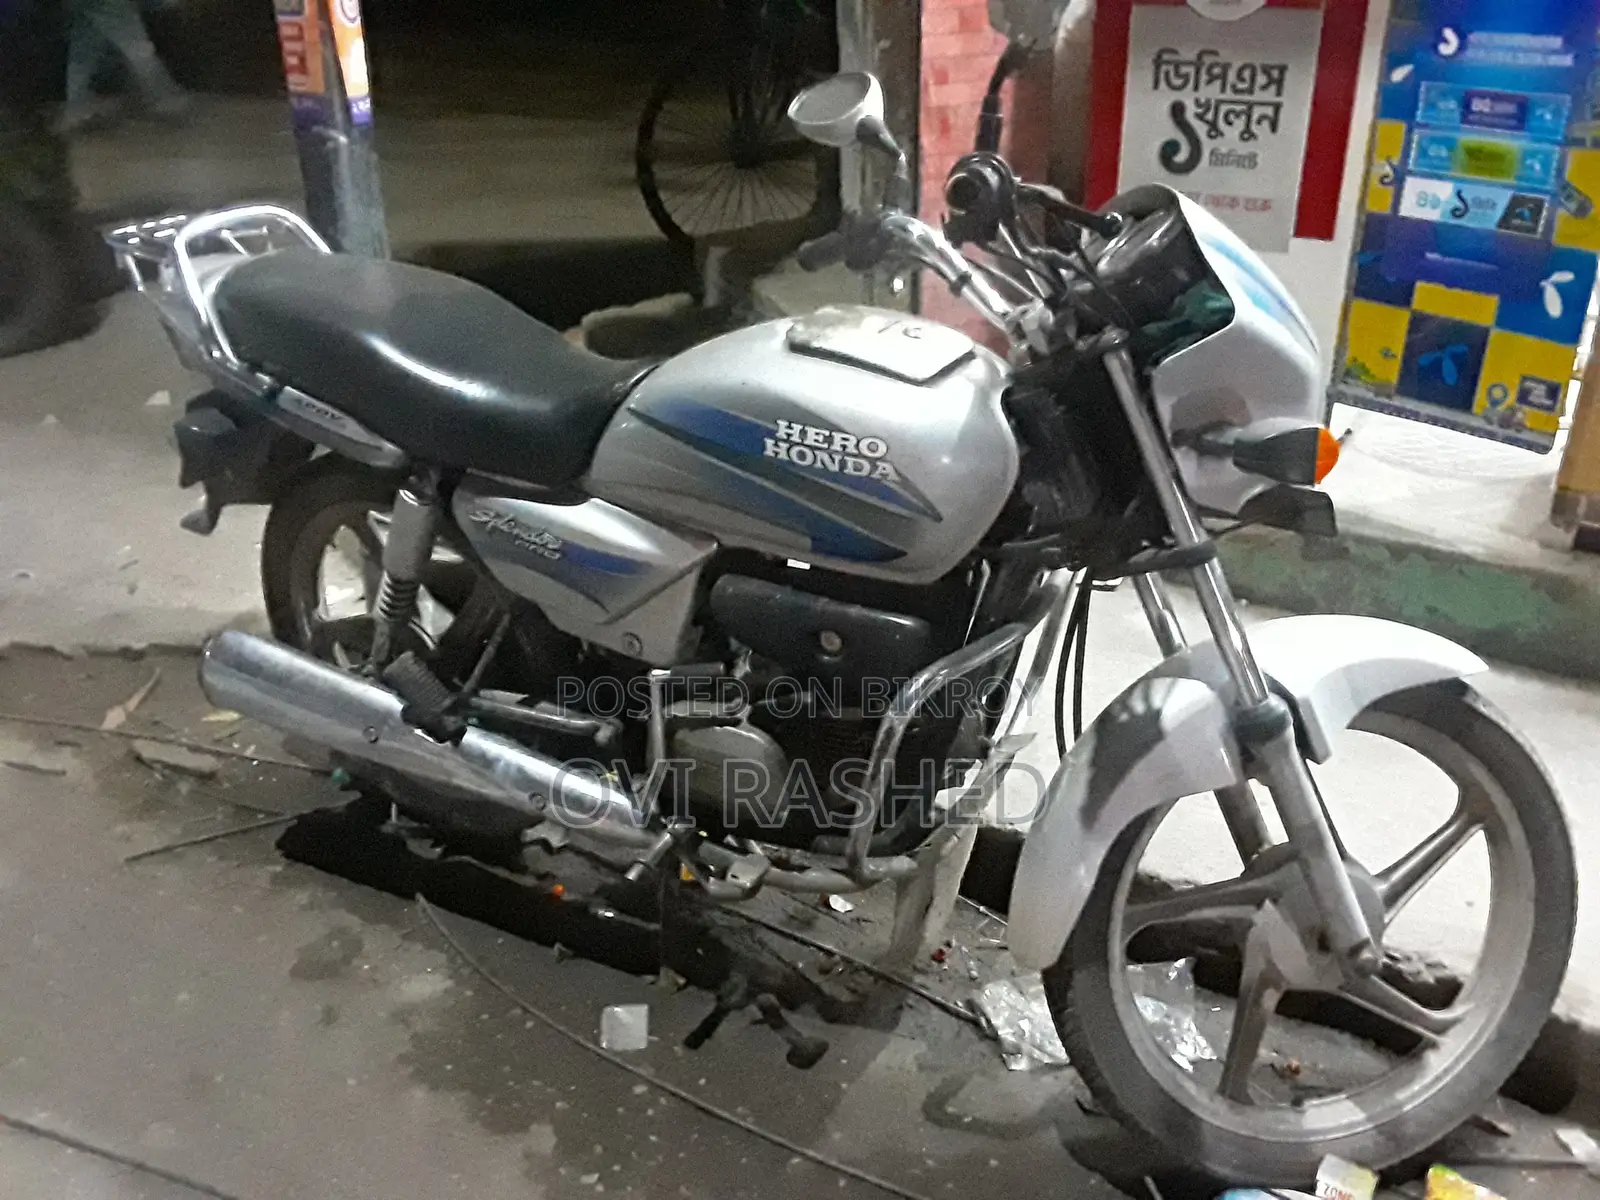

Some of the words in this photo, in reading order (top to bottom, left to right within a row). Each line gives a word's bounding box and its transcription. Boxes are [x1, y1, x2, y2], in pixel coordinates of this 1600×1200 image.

[1152, 47, 1289, 97] ডিপিএস
[1193, 97, 1283, 141] খুলুন
[763, 437, 903, 483] HONDA
[775, 418, 889, 459] HERO
